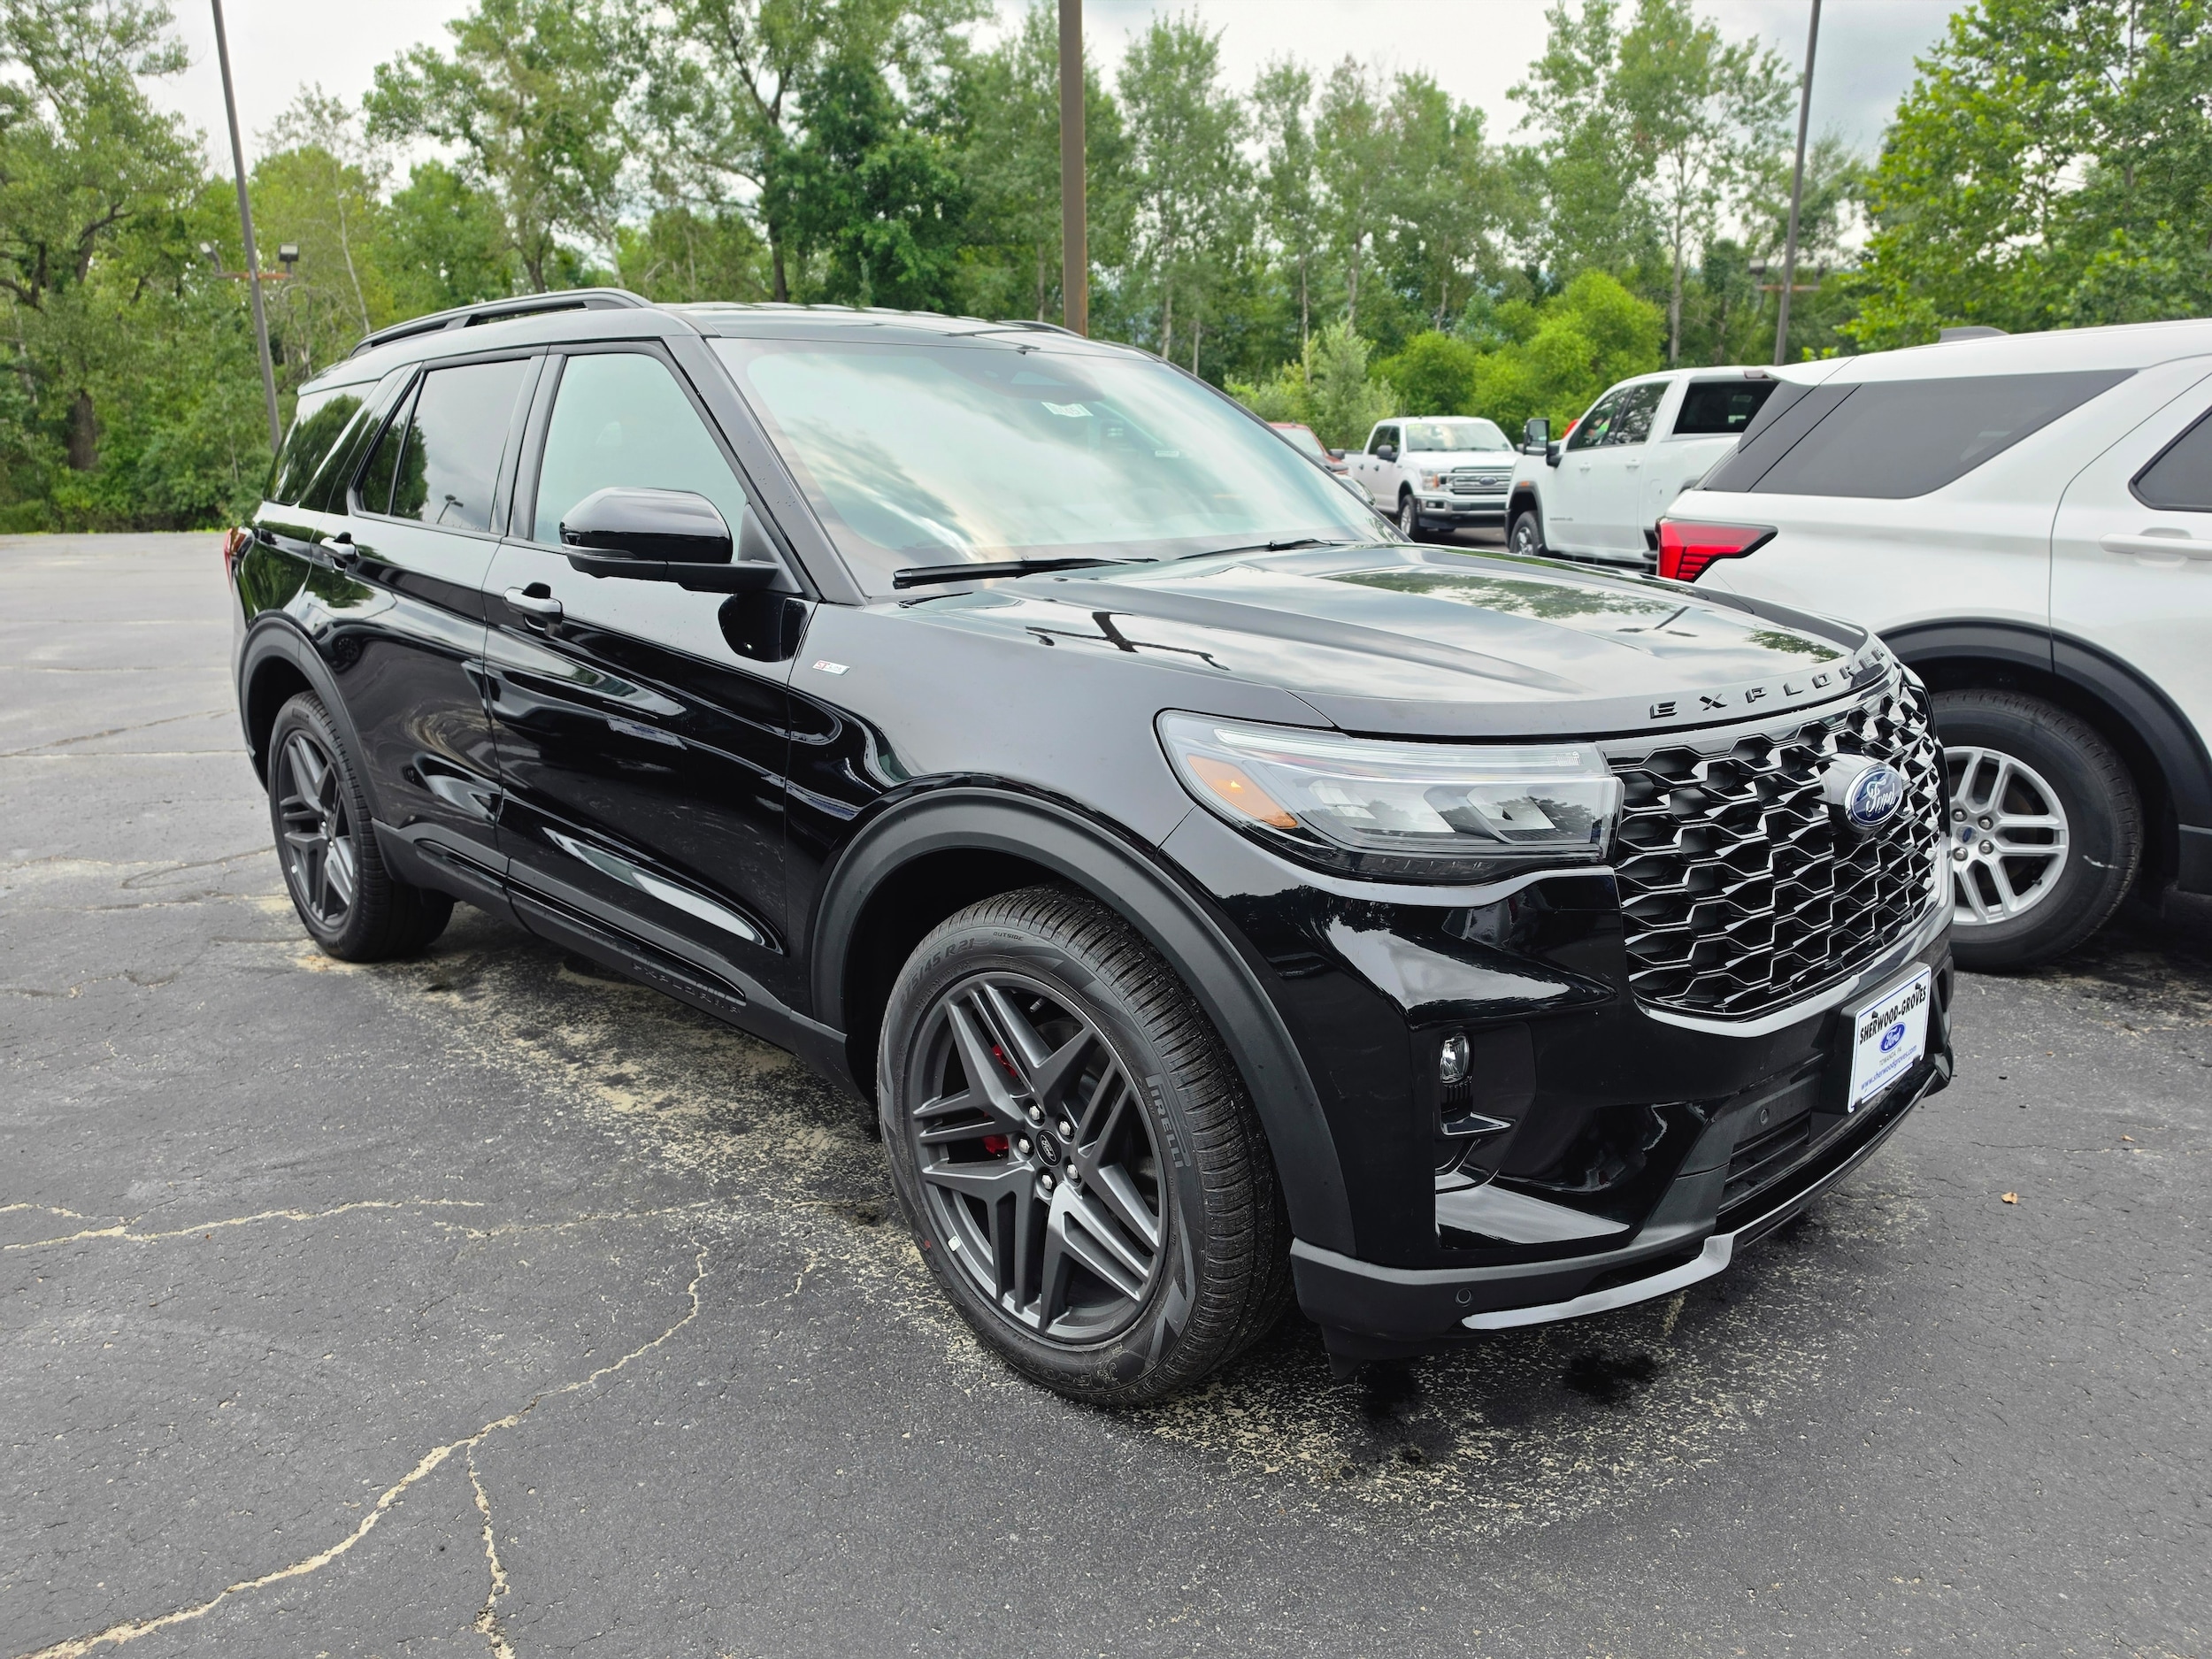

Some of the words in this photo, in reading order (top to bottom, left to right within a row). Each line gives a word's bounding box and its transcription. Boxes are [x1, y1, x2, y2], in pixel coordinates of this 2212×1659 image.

[1650, 646, 1885, 719] EXPLORER
[1867, 778, 1895, 816] Ford
[944, 937, 975, 958] R21
[993, 932, 1024, 941] OUTSIDE
[1860, 986, 1926, 1045] SHERWOOD-GROVES
[1861, 1045, 1916, 1090] www.sherwoodgroves.com
[1145, 1072, 1191, 1168] PIRELLI
